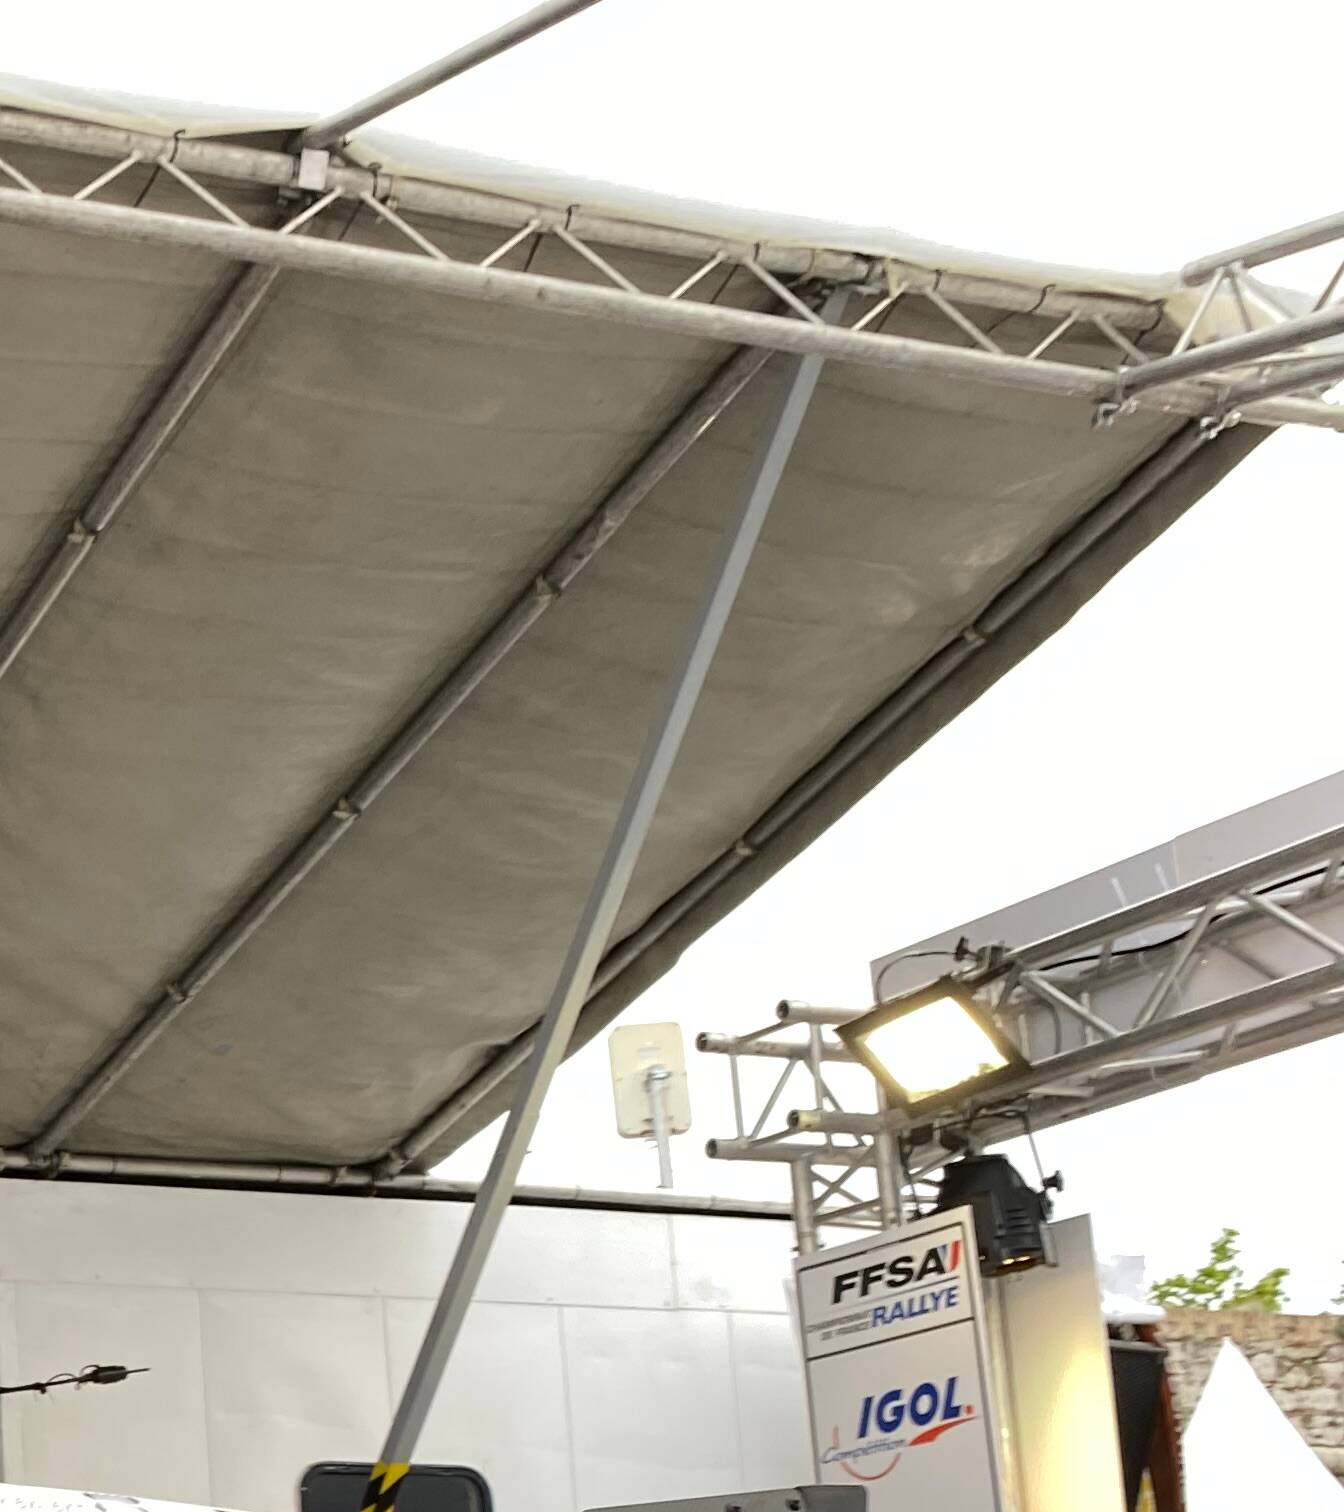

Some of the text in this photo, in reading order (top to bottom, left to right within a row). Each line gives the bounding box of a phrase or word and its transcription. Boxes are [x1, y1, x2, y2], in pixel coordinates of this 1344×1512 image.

[832, 1246, 946, 1304] FFSA
[872, 1286, 958, 1328] RALLYE
[857, 1376, 963, 1439] IGOL
